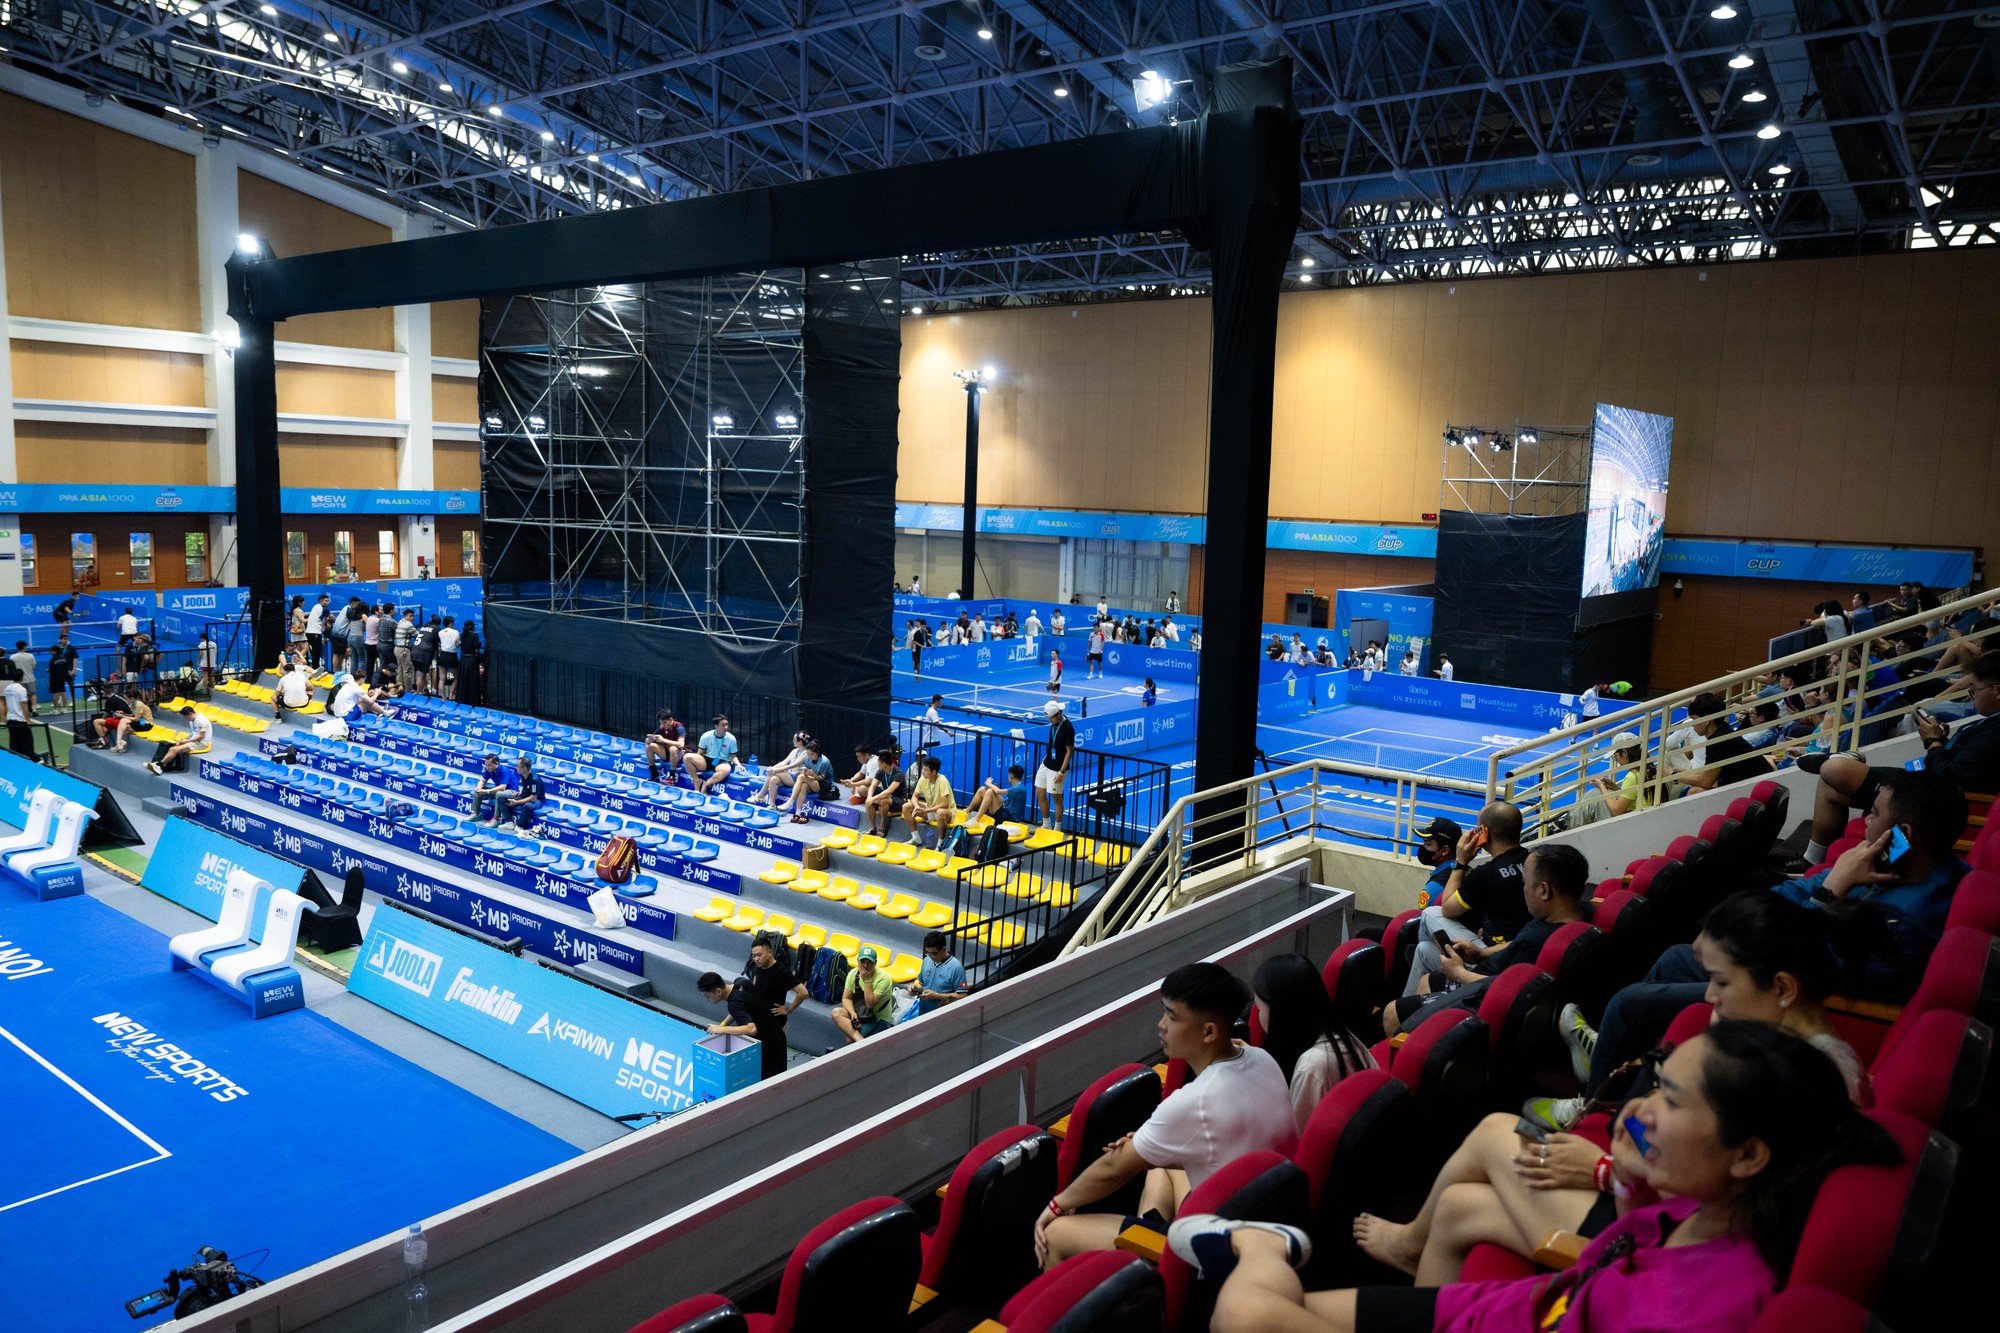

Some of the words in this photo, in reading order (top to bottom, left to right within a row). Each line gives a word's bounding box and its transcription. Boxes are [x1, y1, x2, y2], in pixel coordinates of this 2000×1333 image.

[155, 496, 183, 507] CUP
[311, 495, 346, 503] NEW
[445, 500, 466, 510] CUP
[987, 515, 1015, 523] NEW
[1101, 524, 1120, 534] CUP
[1294, 532, 1310, 541] PPA
[1377, 538, 1404, 551] CUP
[1747, 557, 1781, 571] CUP
[401, 590, 413, 598] MB
[447, 583, 462, 592] PPA
[185, 596, 214, 608] JOOLA
[36, 605, 53, 613] MB
[414, 633, 424, 646] 5
[976, 646, 992, 660] PPA
[1016, 645, 1038, 659] JOA
[933, 656, 945, 667] MB
[1404, 696, 1442, 707] RECOVERY
[1478, 697, 1518, 709] Healthcare
[408, 711, 418, 722] MB
[1549, 706, 1569, 719] MB
[438, 719, 449, 729] MB
[1162, 717, 1175, 731] MB
[355, 732, 365, 742] MB
[471, 727, 482, 737] MB
[1116, 721, 1143, 743] JOOLA
[386, 740, 396, 750] MB
[506, 735, 518, 745] MB
[418, 748, 429, 758] MB
[542, 744, 554, 754] MB
[452, 757, 464, 767] MB
[581, 753, 593, 763] MB
[209, 767, 220, 780] MB
[326, 762, 337, 772] MB
[621, 763, 635, 773] MB
[635, 762, 650, 770] PRIORIT
[358, 771, 369, 781] MB
[247, 780, 259, 792] MB
[392, 781, 403, 791] MB
[567, 786, 580, 798] MB
[711, 782, 726, 794] MB
[288, 794, 300, 807] MB
[300, 795, 317, 804] PRIORITY
[428, 792, 438, 803] MB
[610, 797, 623, 810] MB
[184, 795, 197, 814] MB
[197, 798, 215, 810] PRIORITY
[331, 807, 345, 822] MB
[345, 809, 363, 819] PRIORITY
[656, 809, 670, 822] MB
[670, 811, 689, 820] PRIORITY
[811, 805, 828, 818] MB
[829, 806, 850, 816] PRIORITY
[232, 814, 246, 833] MB
[247, 816, 267, 830] PRIORITY
[705, 823, 720, 835] MB
[720, 824, 740, 833] PRIORITY
[379, 823, 393, 838] MB
[394, 825, 413, 837] PRIORITY
[547, 826, 560, 838] MB
[561, 827, 579, 836] PRIORITY
[285, 833, 301, 852] MB
[302, 836, 324, 851] PRIORITY
[430, 840, 446, 857] MB
[447, 843, 468, 856] PRIORITY
[593, 839, 607, 852] MB
[757, 836, 773, 849] MB
[773, 838, 794, 847] PRIORITY
[199, 850, 243, 878] NEW
[642, 852, 657, 866] MB
[657, 855, 677, 865] PRIORITY
[364, 859, 389, 874] PRIORITY
[487, 859, 504, 877] MB
[505, 862, 528, 875] PRIORITY
[1498, 863, 1517, 879] Bố
[47, 875, 75, 886] NEW
[693, 868, 709, 881] MB
[710, 871, 732, 880] PRIORITY
[48, 880, 76, 890] SPORTS
[194, 872, 228, 897] SPORT
[549, 879, 567, 898] MB
[569, 883, 594, 896] PRIORITY
[412, 880, 432, 903] MB
[433, 884, 460, 901] PRIORITY
[619, 901, 637, 922] MB
[640, 905, 666, 921] PRIORITY
[488, 907, 510, 932] MB
[512, 912, 542, 931] PRIORITY
[573, 938, 598, 962] MB
[601, 945, 635, 964] PRIORITY
[0, 941, 55, 981] NOI
[387, 946, 437, 990] JOOLA
[263, 984, 294, 998] NEW
[264, 991, 295, 1003] SPORTS
[552, 1018, 615, 1060] KAIWIN
[92, 1011, 164, 1045] NEW
[143, 1043, 250, 1102] SPORTS
[137, 1058, 177, 1084] change
[623, 1037, 693, 1092] NEW
